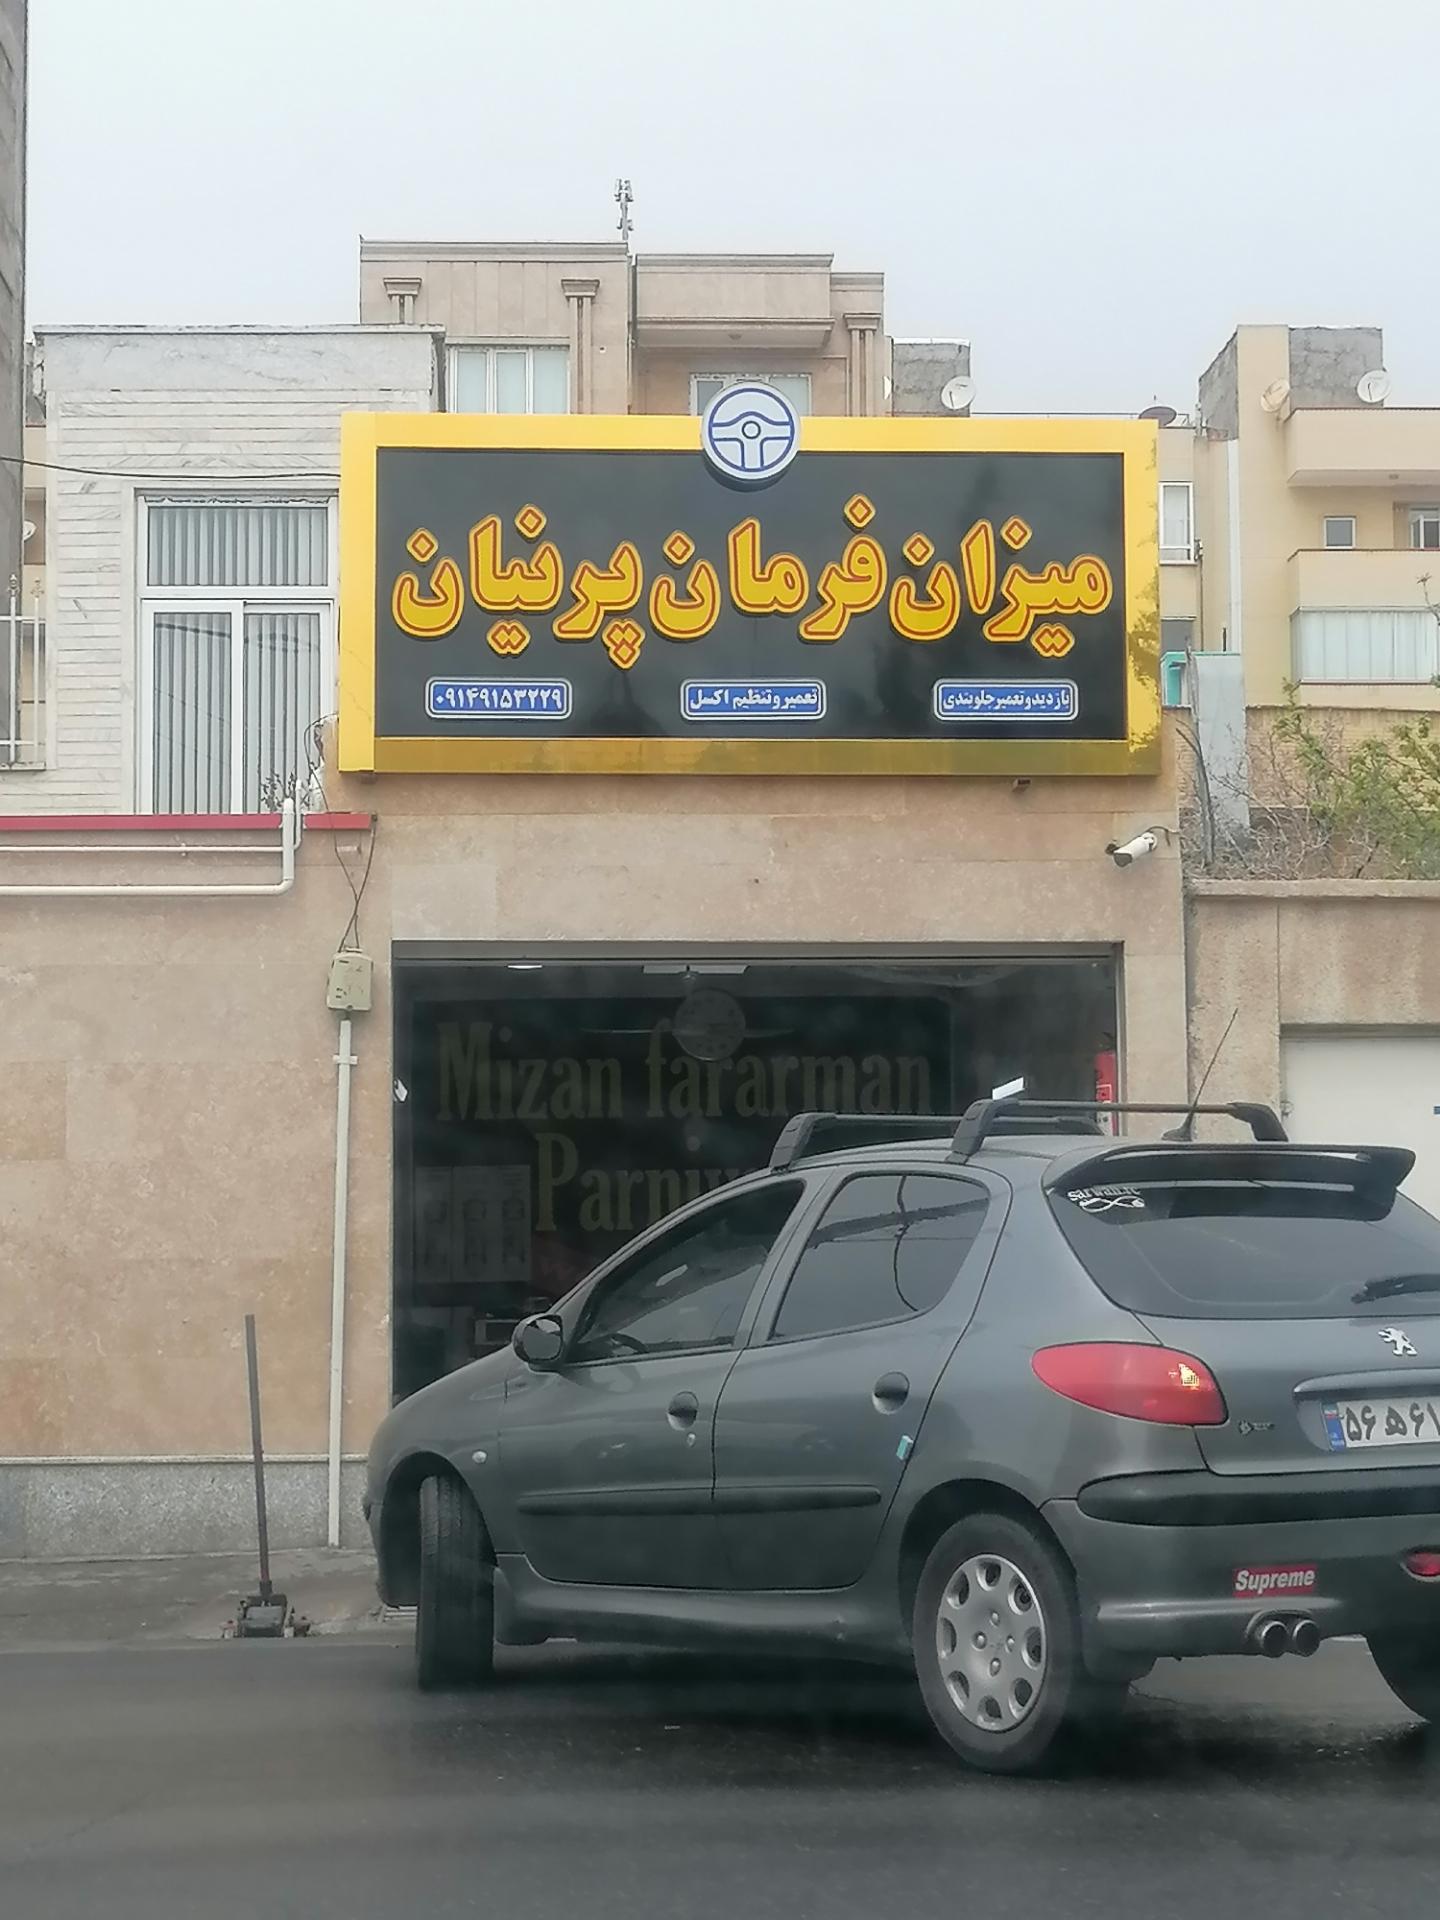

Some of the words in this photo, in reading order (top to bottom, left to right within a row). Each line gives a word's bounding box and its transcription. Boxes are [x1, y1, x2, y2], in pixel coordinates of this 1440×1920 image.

[391, 504, 645, 669] پرنیان
[649, 493, 888, 642] فرمان
[890, 516, 1113, 658] میزان
[436, 687, 562, 709] ۰۹۱۴۹۱۵۳۲۲۹
[689, 688, 729, 709] اکسل
[437, 1021, 624, 1120] Mizan
[645, 1017, 932, 1118] fararman
[1235, 1569, 1315, 1595] Supreme
